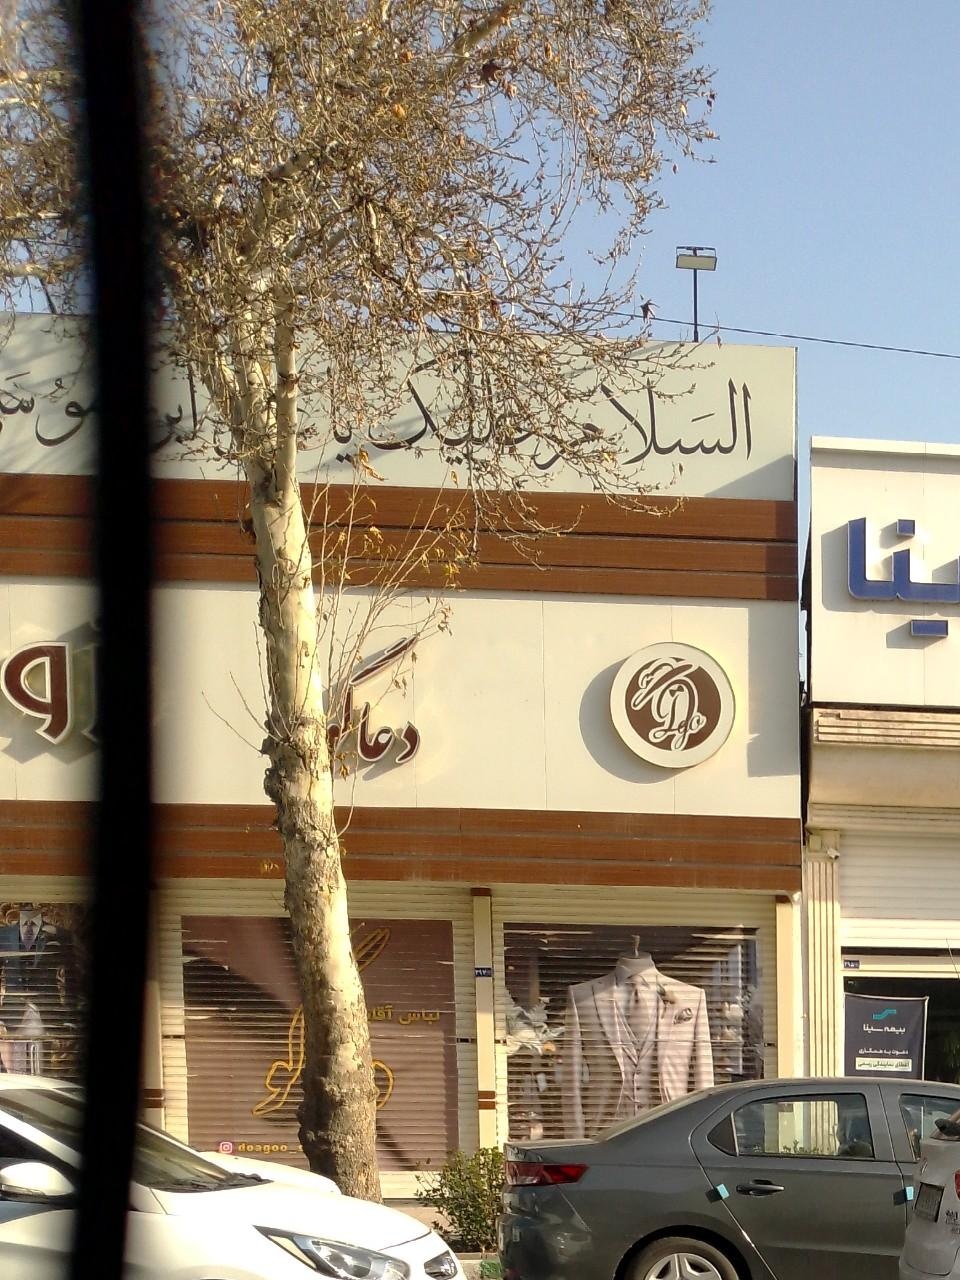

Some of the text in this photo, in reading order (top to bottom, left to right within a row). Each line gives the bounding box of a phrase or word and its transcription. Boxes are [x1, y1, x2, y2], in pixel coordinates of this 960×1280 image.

[399, 1008, 440, 1025] لباس
[863, 1023, 906, 1035] بیمه سینا
